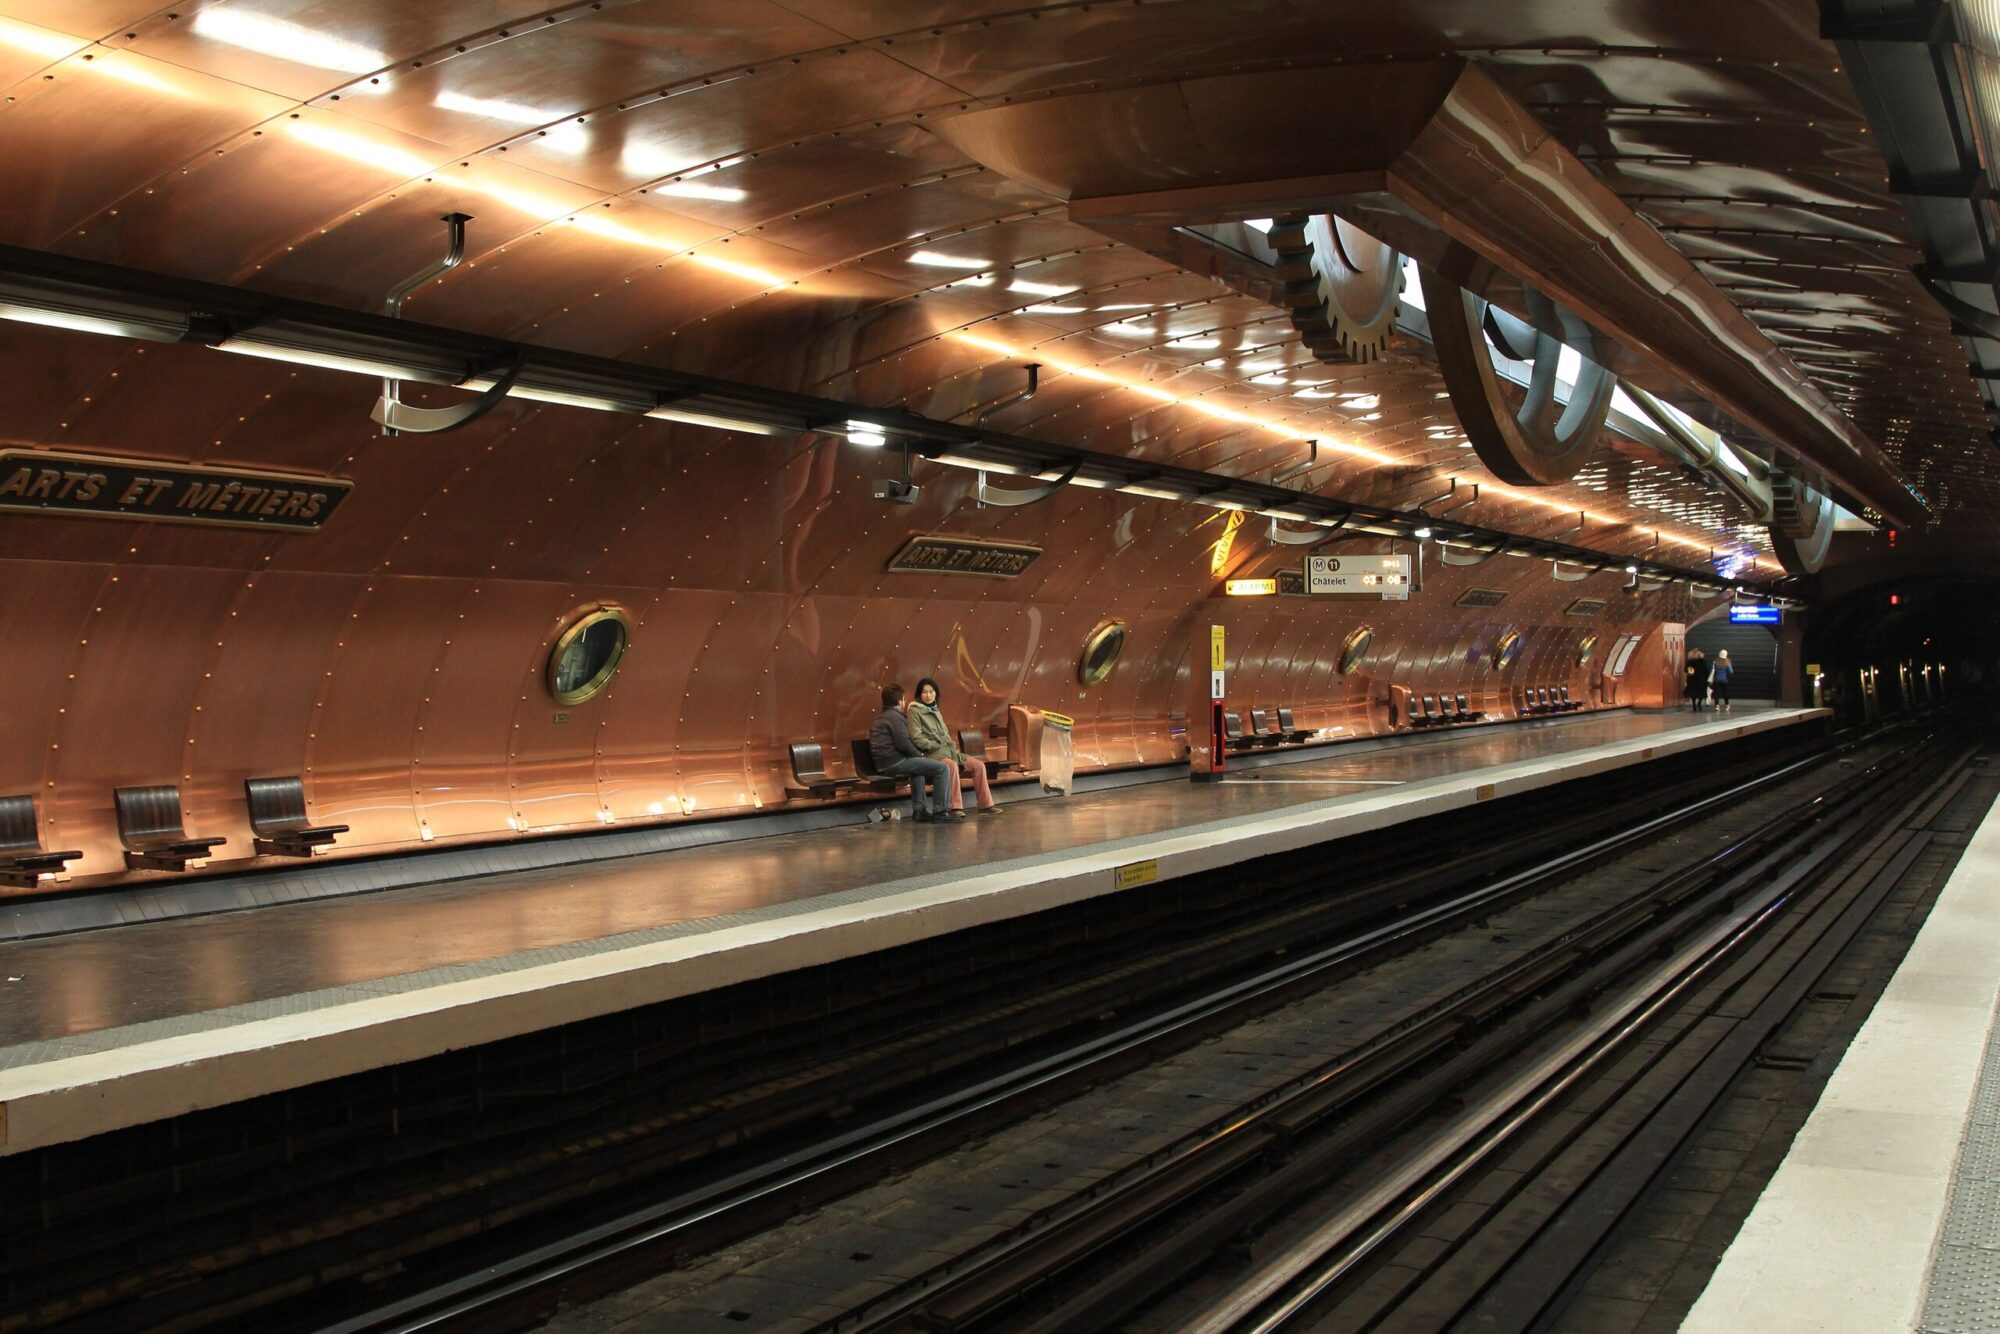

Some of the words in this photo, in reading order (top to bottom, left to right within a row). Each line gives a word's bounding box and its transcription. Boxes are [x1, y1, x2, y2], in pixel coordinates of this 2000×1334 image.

[1, 468, 107, 501] ARTS
[119, 477, 173, 505] ET
[177, 481, 327, 518] MÉTIERS
[904, 547, 947, 565] ARTS
[946, 549, 972, 567] ET
[1312, 577, 1346, 586] Châtelet
